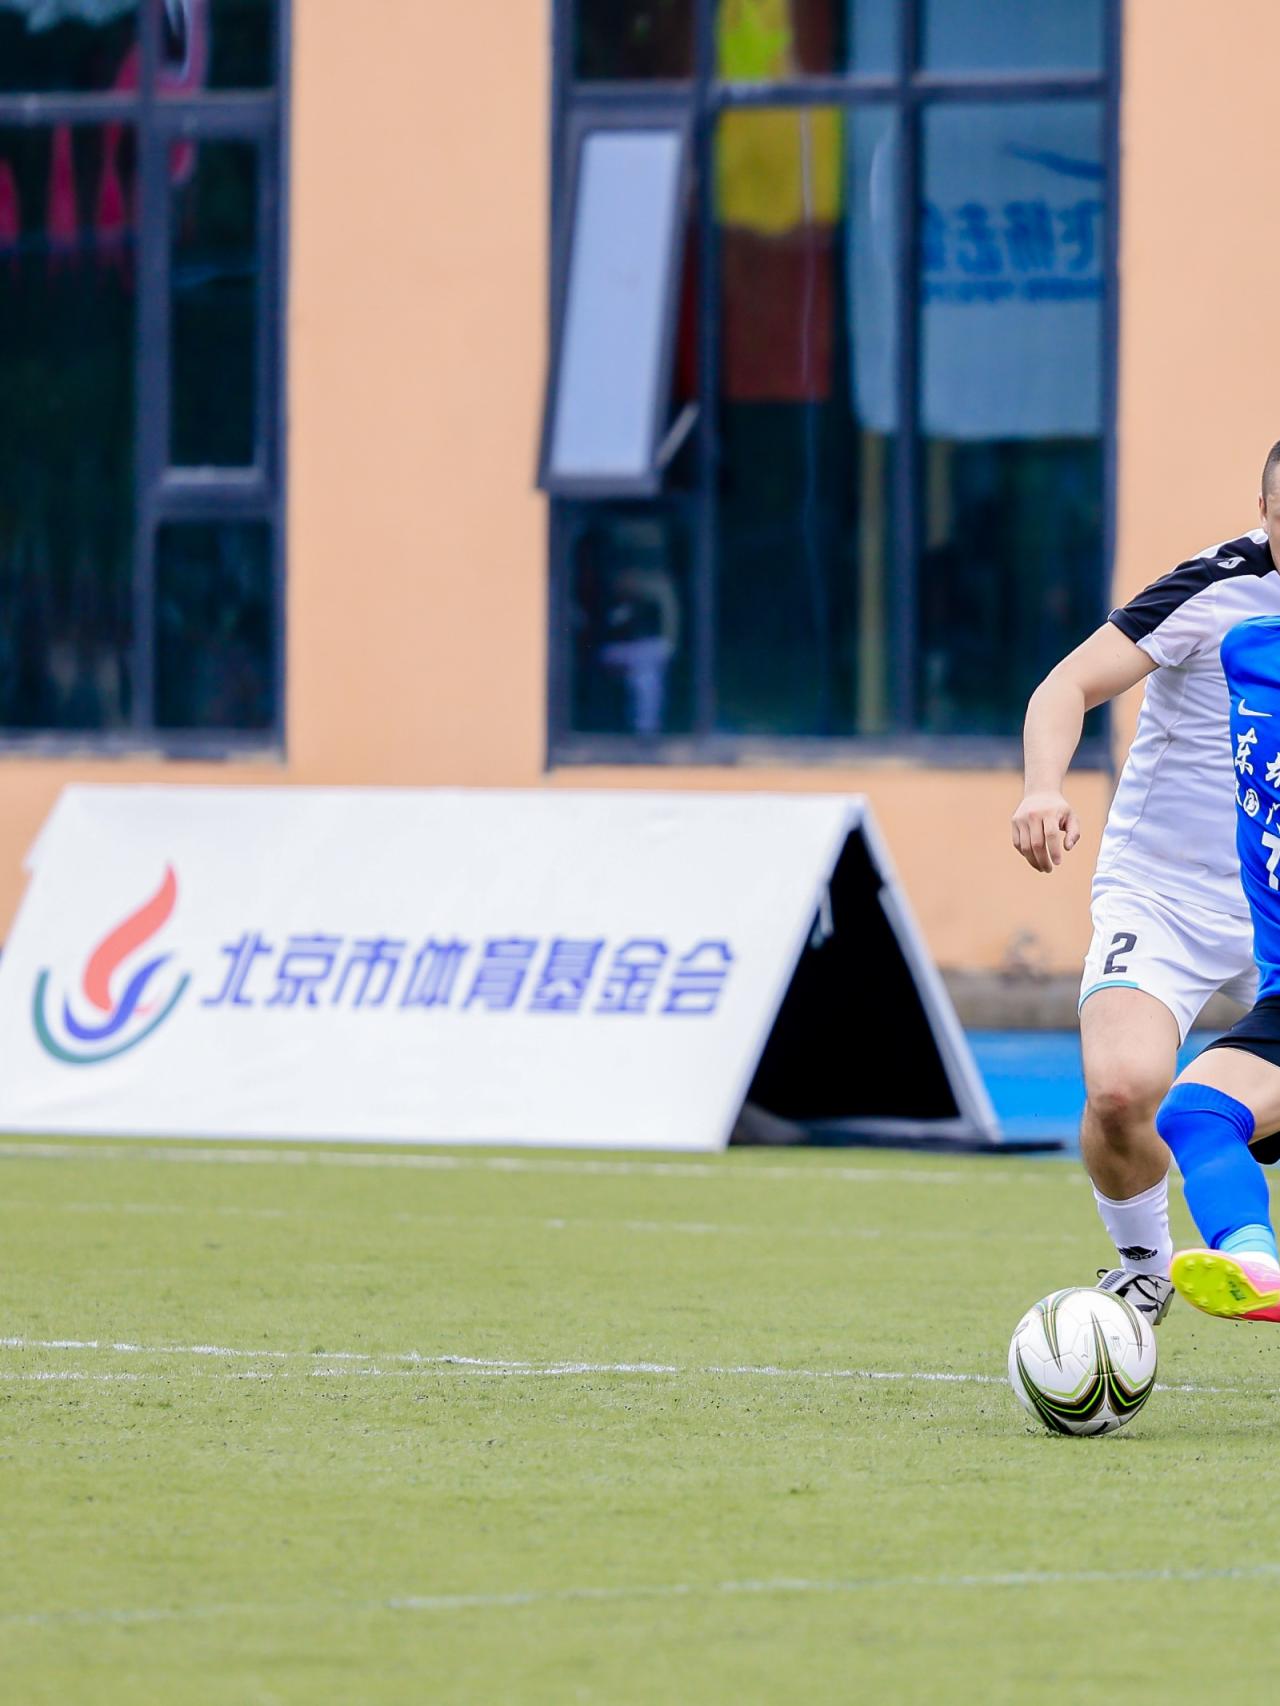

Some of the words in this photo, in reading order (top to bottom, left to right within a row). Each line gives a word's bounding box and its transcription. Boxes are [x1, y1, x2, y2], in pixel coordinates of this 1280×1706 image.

[198, 932, 735, 1016] 北京市体育基金会
[1103, 931, 1138, 975] 2
